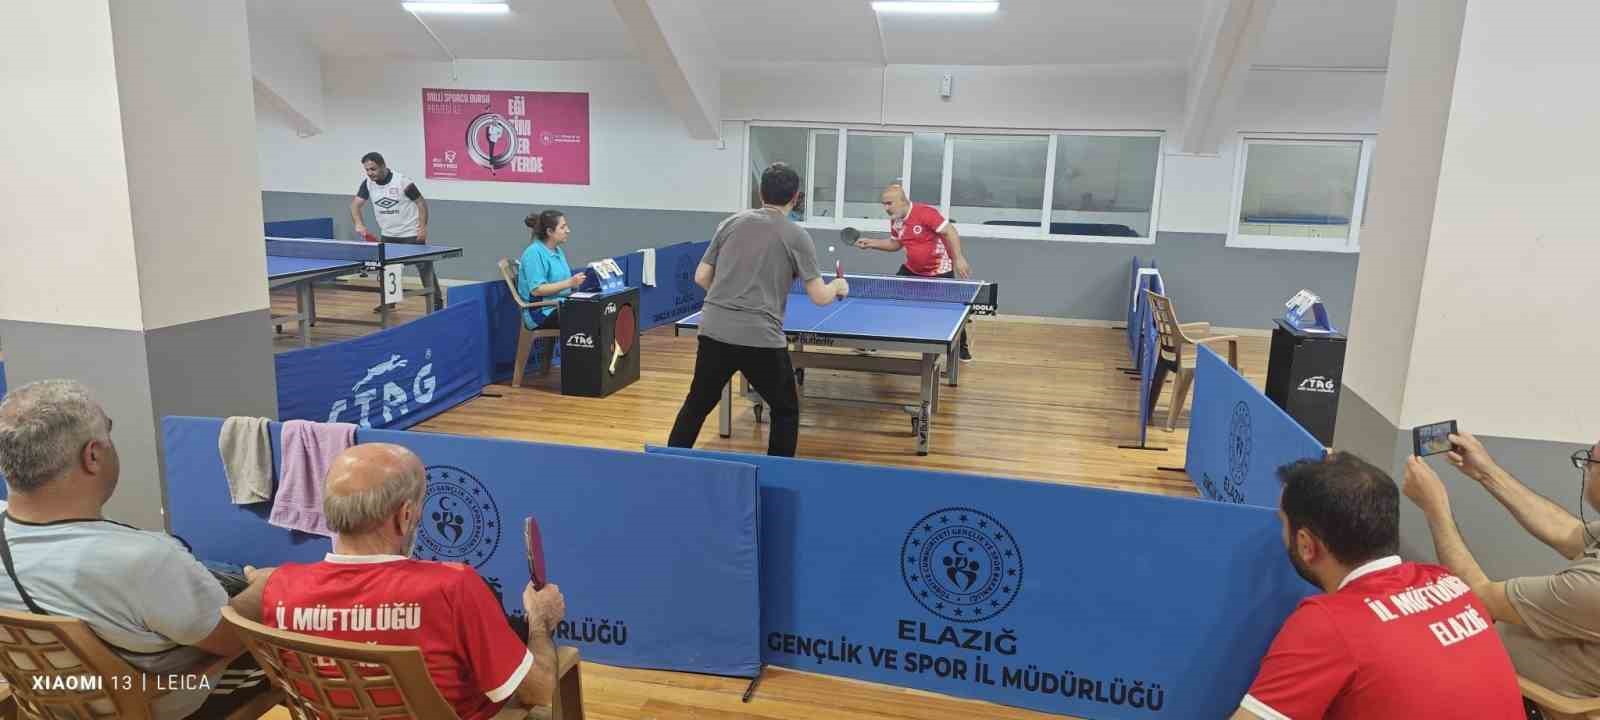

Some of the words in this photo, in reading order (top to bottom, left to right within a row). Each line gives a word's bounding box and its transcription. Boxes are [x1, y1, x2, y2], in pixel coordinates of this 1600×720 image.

[389, 272, 397, 295] 3
[567, 335, 593, 345] STAG
[1299, 378, 1334, 389] STAG
[1363, 597, 1400, 622] İL
[1389, 573, 1471, 616] MÜFTÜLÜ
[276, 601, 288, 630] İL
[293, 603, 421, 632] MÜFTÜLÜĞÜ
[897, 620, 1018, 655] ELAZIĞ
[767, 631, 863, 664] GENÇLİK
[868, 647, 898, 670] VE
[904, 652, 966, 681] SPOR
[974, 655, 995, 686] İL
[1001, 666, 1165, 711] MÜDÜRLÜĞÜ
